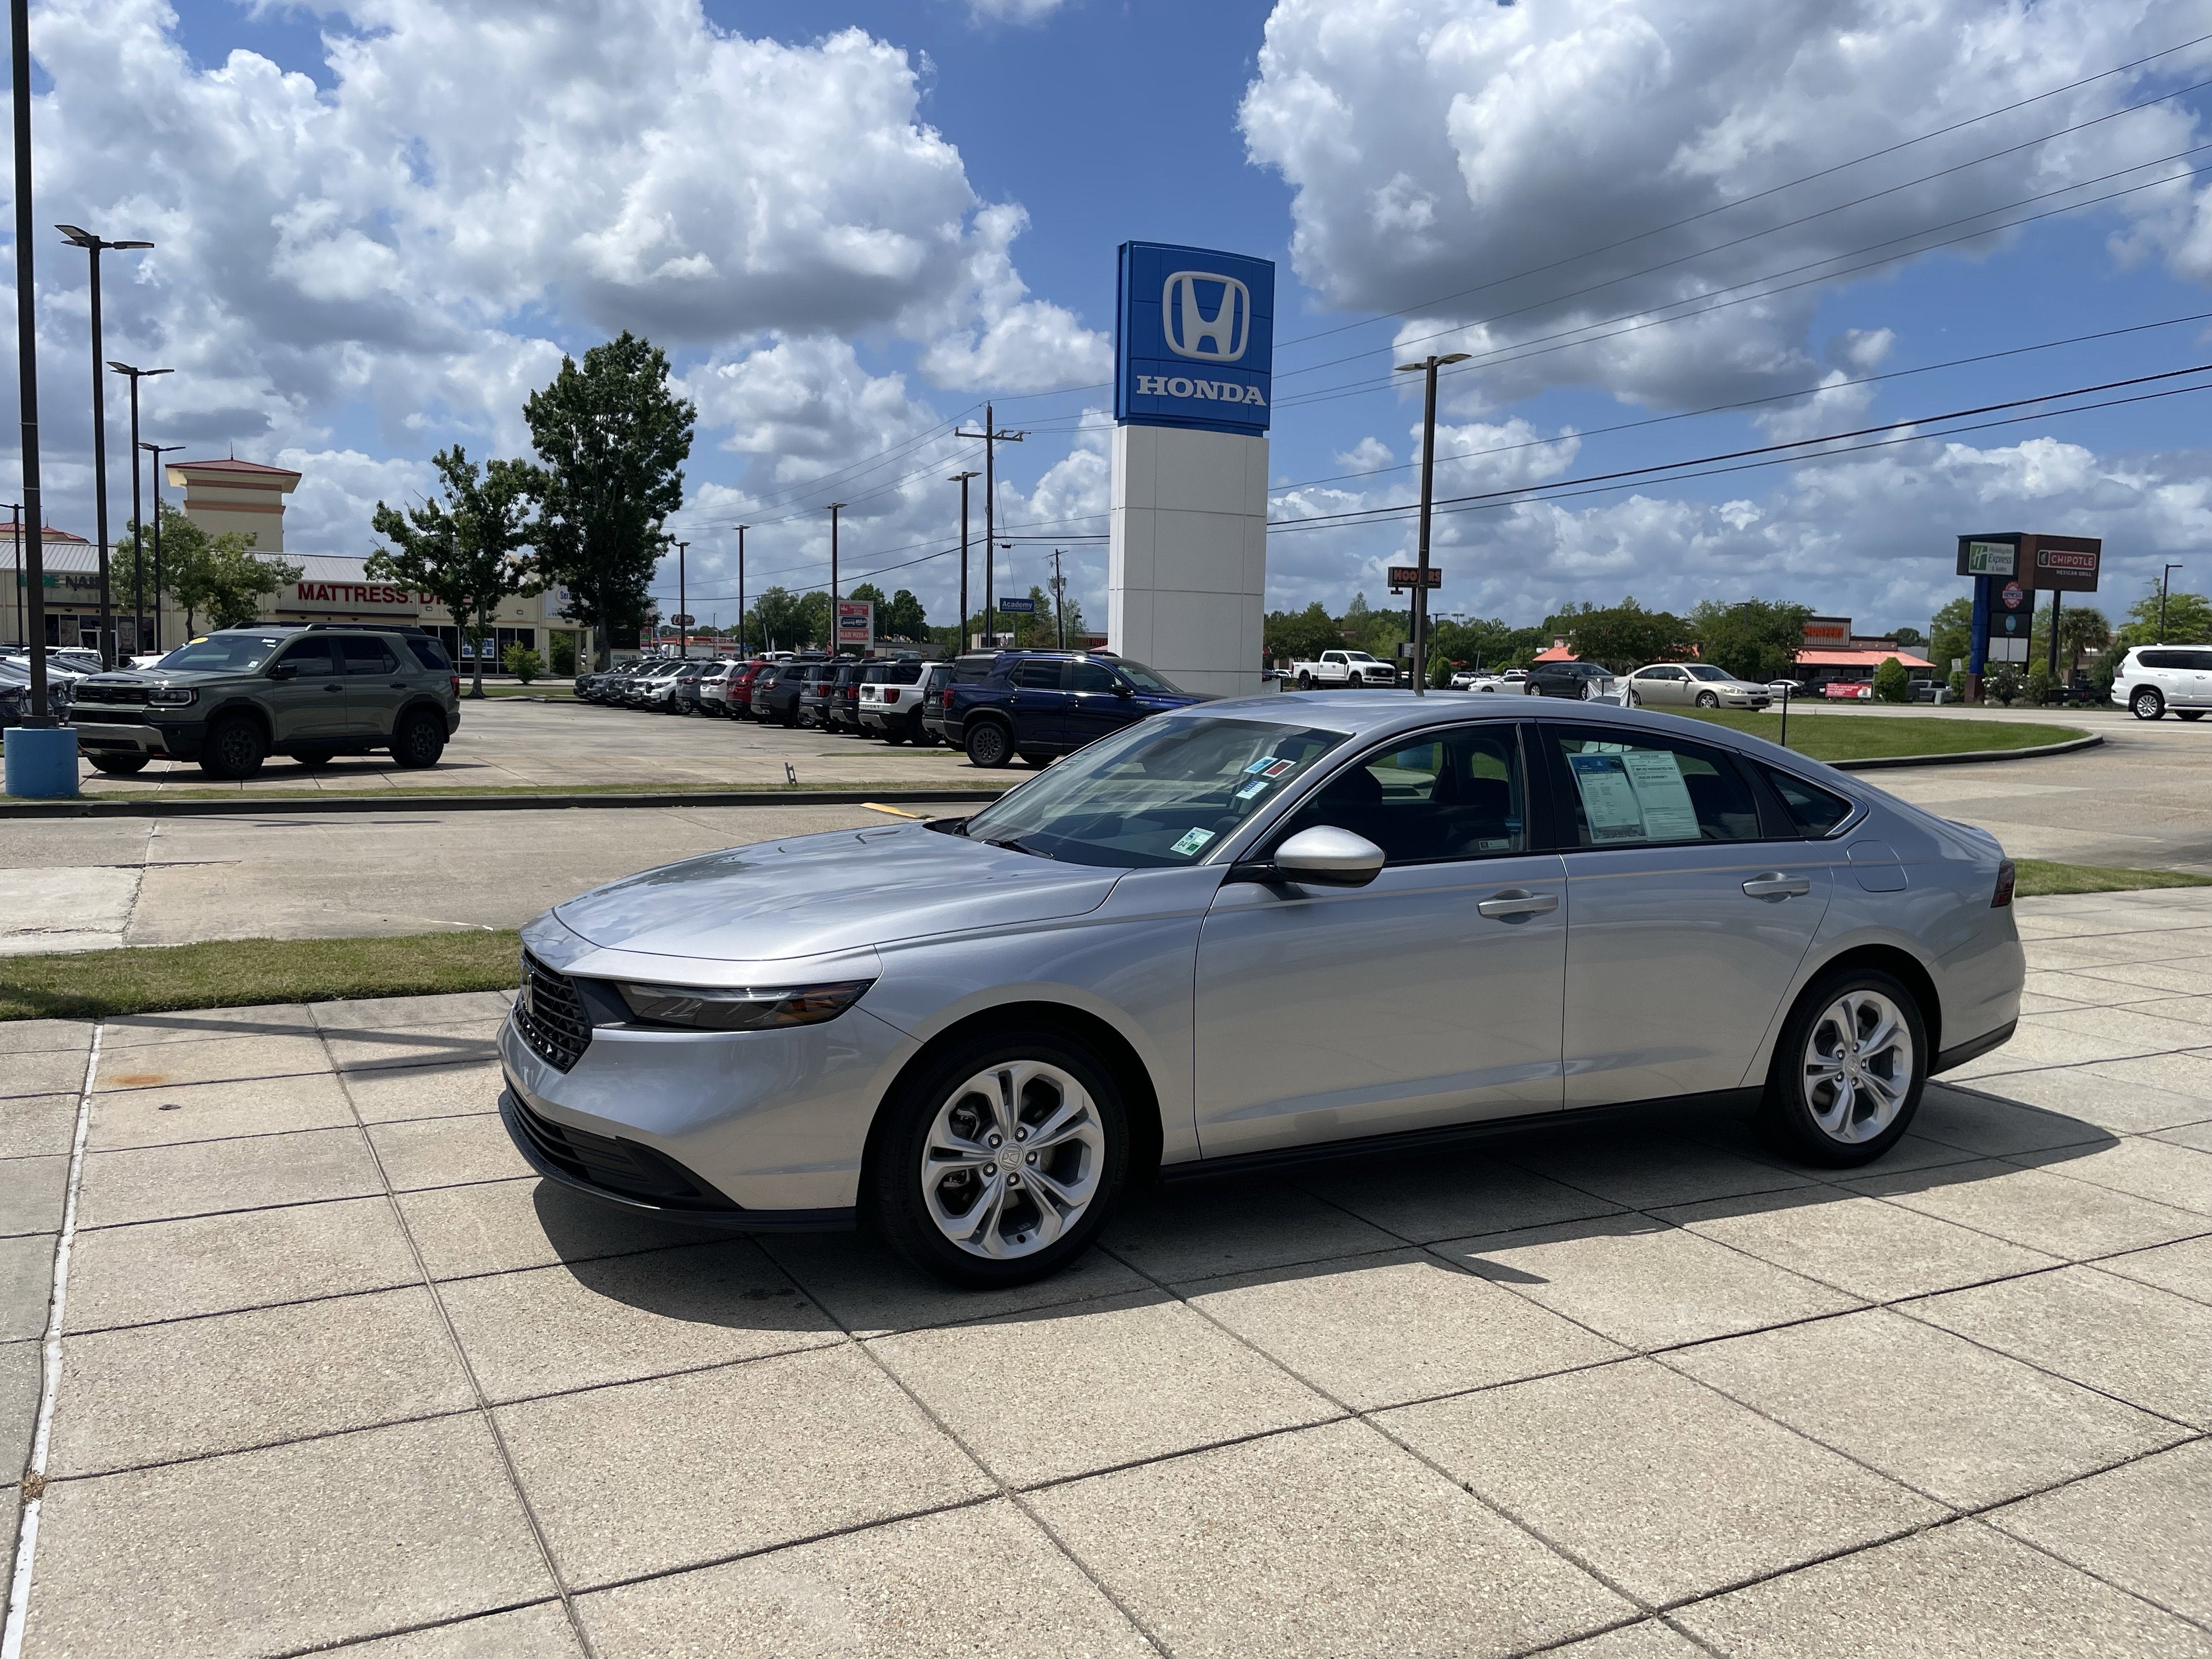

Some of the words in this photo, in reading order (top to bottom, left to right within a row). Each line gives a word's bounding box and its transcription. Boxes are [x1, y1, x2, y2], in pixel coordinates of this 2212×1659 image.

[1137, 375, 1267, 406] HONDA
[1988, 554, 2012, 565] Express
[2051, 555, 2094, 566] CHIPOTLE
[1394, 569, 1441, 582] HOORS
[298, 584, 409, 603] MATTRESS
[1002, 601, 1032, 610] Academy
